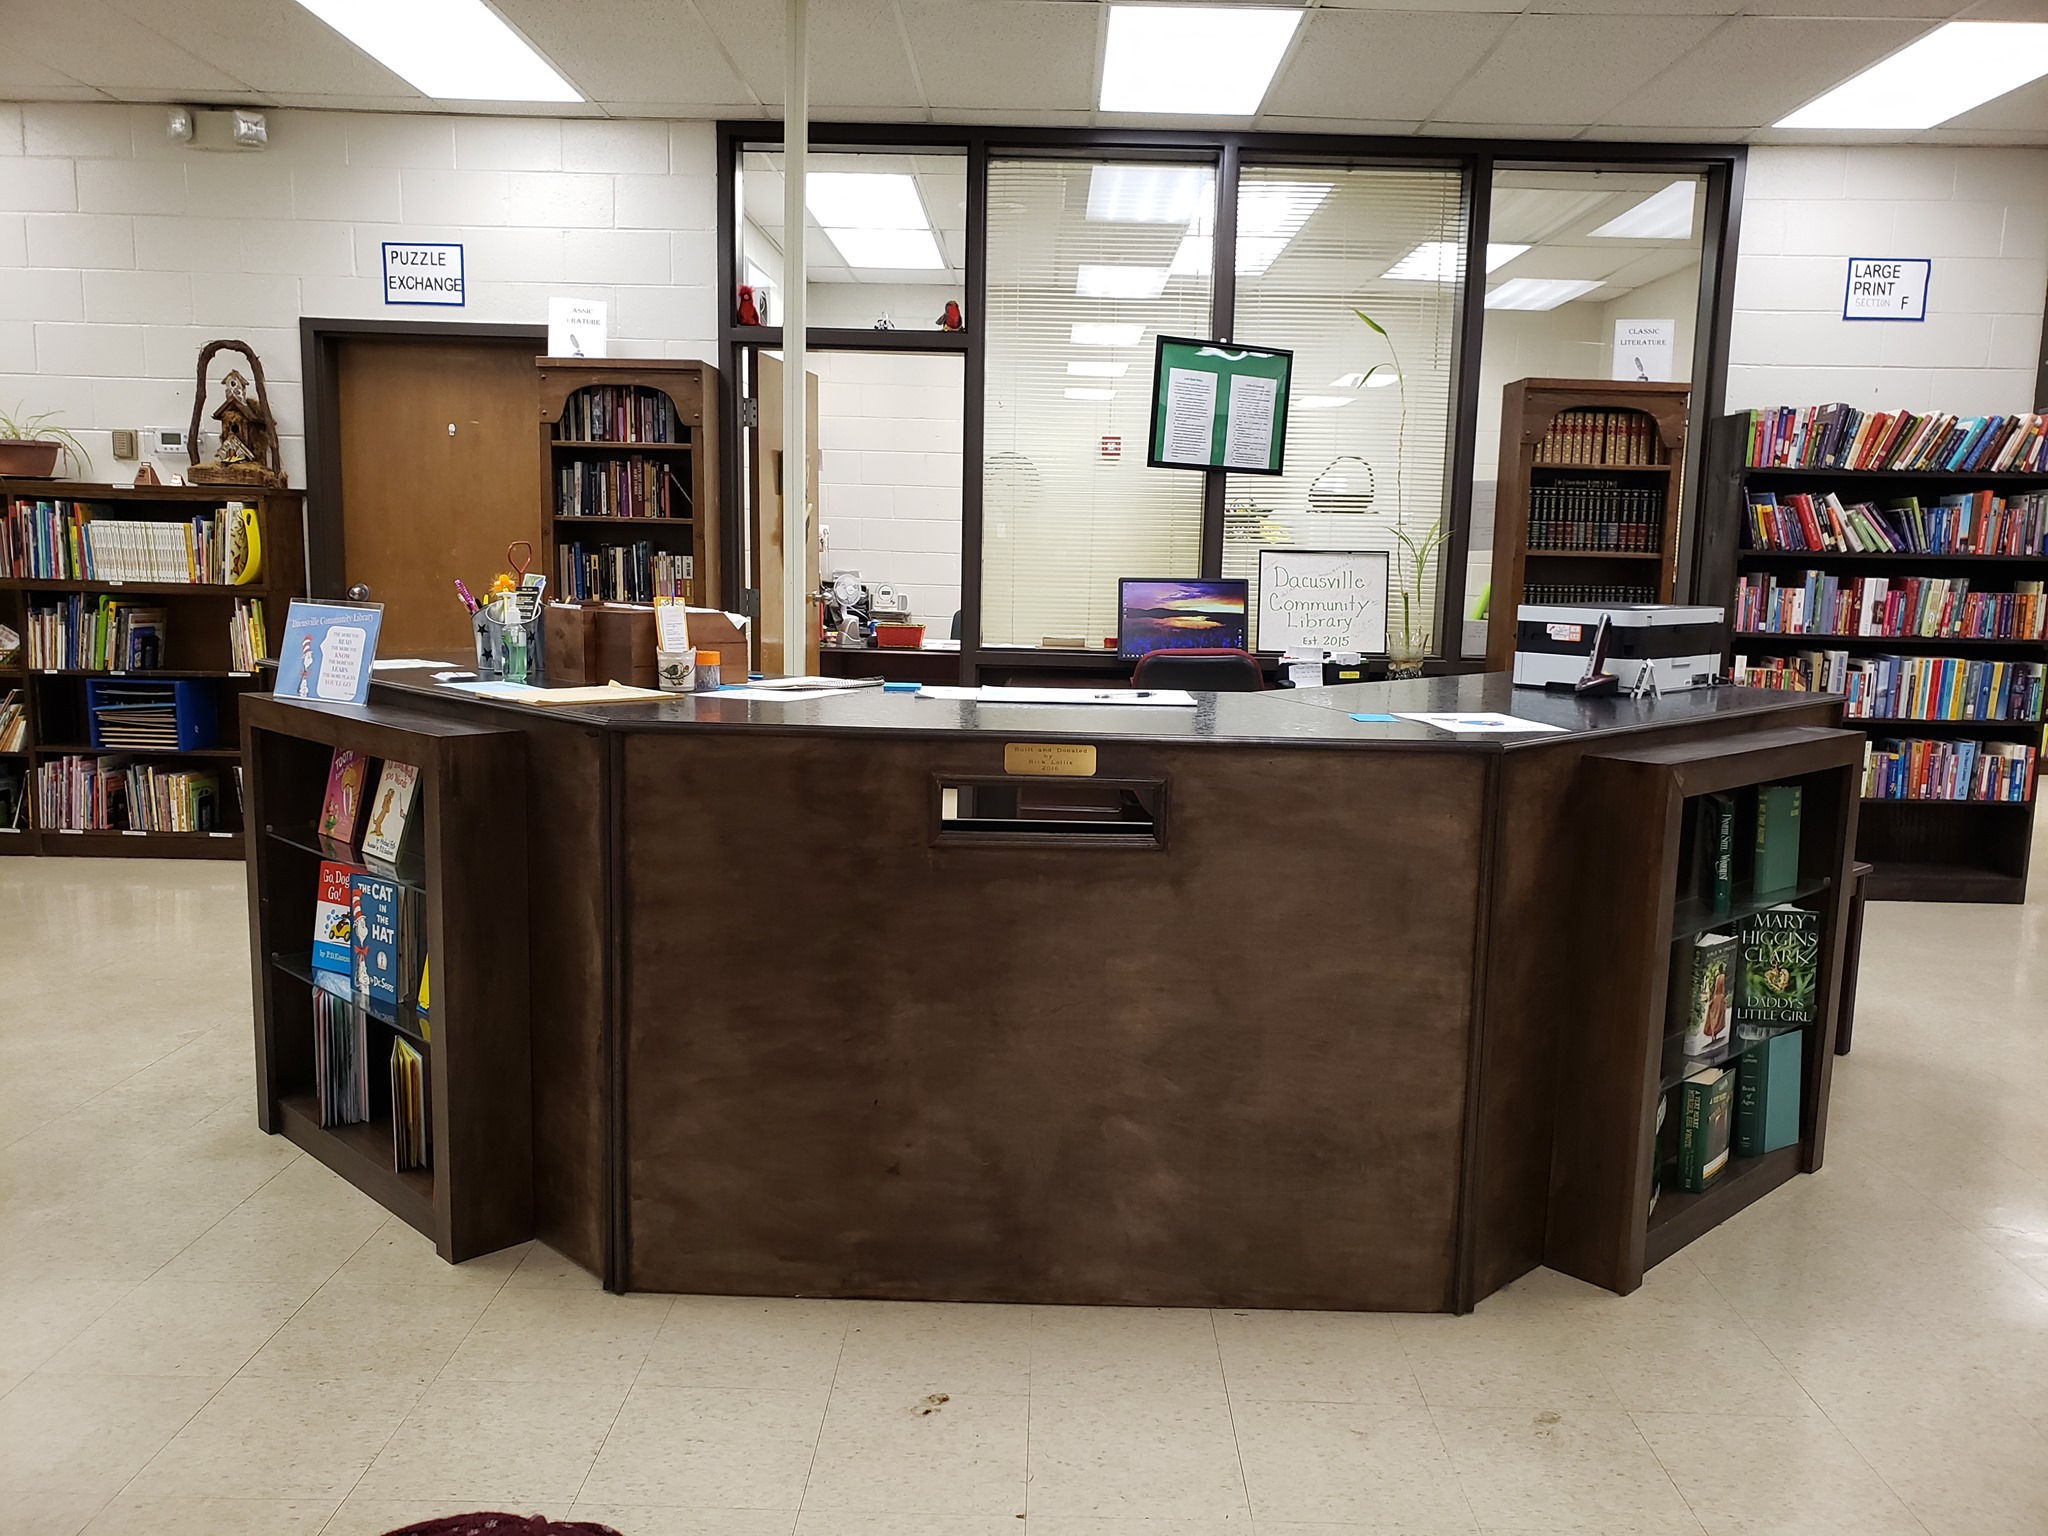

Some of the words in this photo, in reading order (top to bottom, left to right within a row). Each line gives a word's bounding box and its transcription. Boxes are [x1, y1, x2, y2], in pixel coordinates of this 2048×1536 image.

[390, 250, 446, 266] PUZZLE
[1855, 264, 1902, 279] LARGE
[388, 275, 463, 292] EXCHANGE
[1853, 281, 1896, 296] PRINT
[1855, 297, 1891, 307] SECTION
[1901, 296, 1910, 310] F
[1274, 566, 1365, 589] Dacusville
[1269, 592, 1370, 618] Community
[292, 616, 320, 628] Dacusville
[320, 613, 351, 625] Community
[353, 612, 373, 623] Library
[1287, 612, 1353, 634] Library
[1323, 635, 1350, 647] 2015
[328, 886, 342, 902] Go!
[358, 883, 372, 895] THE
[371, 884, 393, 903] CAT
[379, 904, 387, 913] IN
[376, 914, 389, 926] THE
[1754, 913, 1816, 929] MARY
[372, 924, 394, 945] HAT
[1742, 930, 1818, 947] HIGGINS
[1744, 946, 1817, 964] CLARK
[1747, 995, 1804, 1009] DADDY'S
[1737, 1008, 1778, 1020] LITTLE
[1780, 1009, 1812, 1022] GIRL
